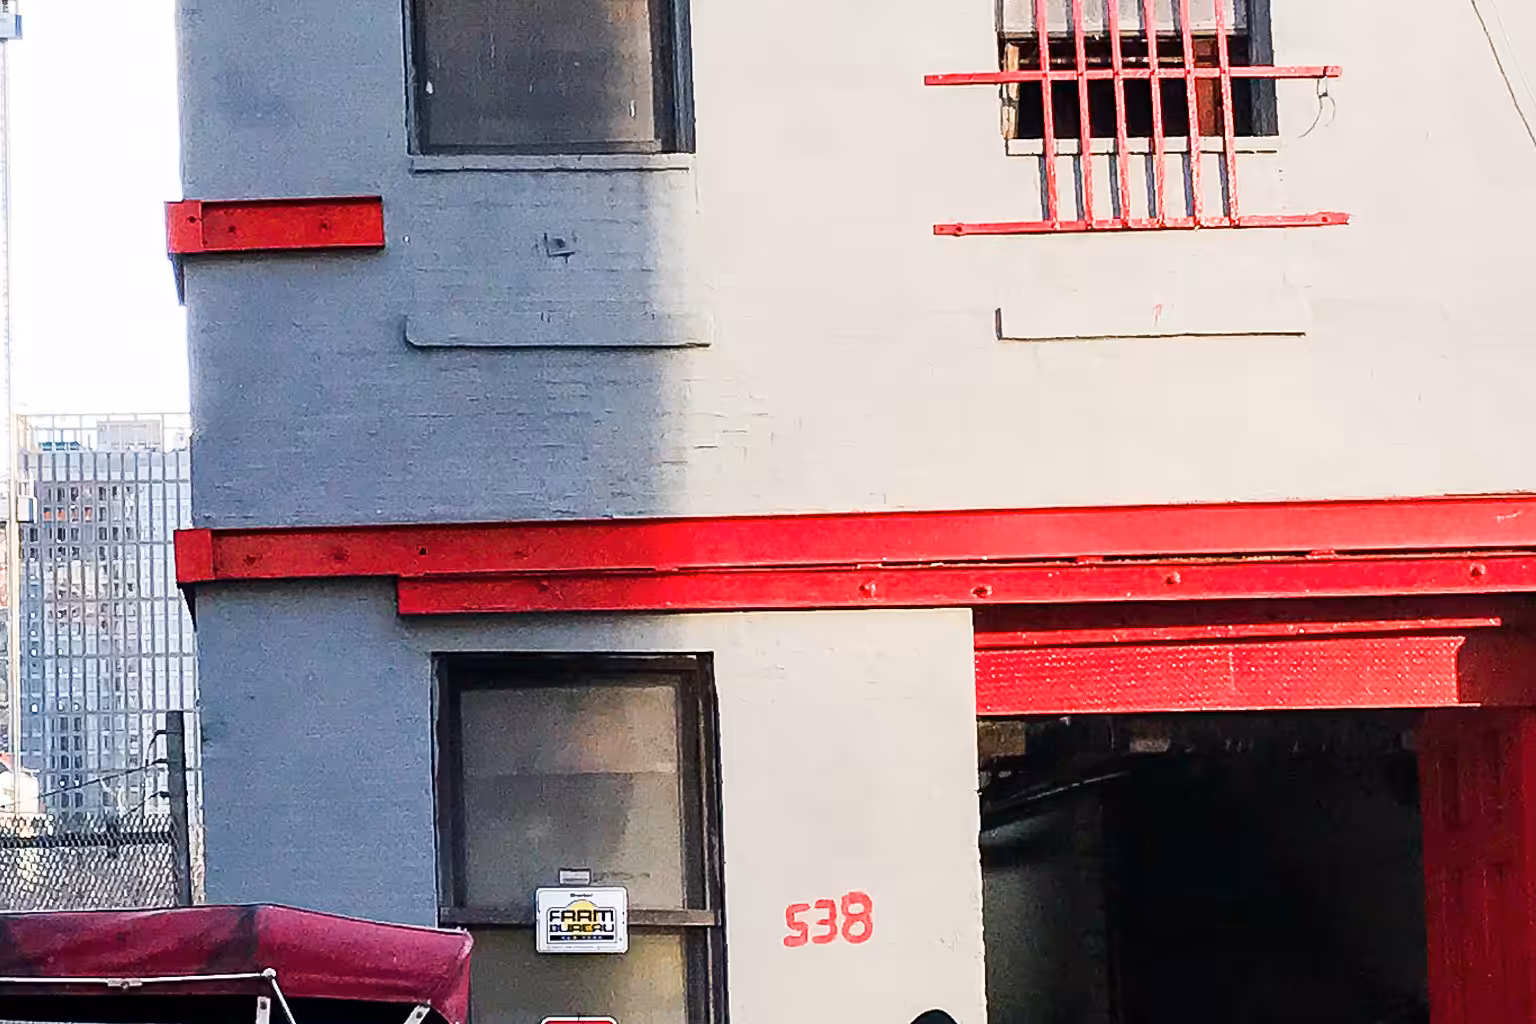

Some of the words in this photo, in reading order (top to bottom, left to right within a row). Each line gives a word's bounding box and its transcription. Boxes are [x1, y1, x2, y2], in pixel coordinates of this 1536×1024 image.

[549, 909, 614, 922] FARM
[783, 891, 873, 947] 538
[549, 923, 615, 933] BUREAU
